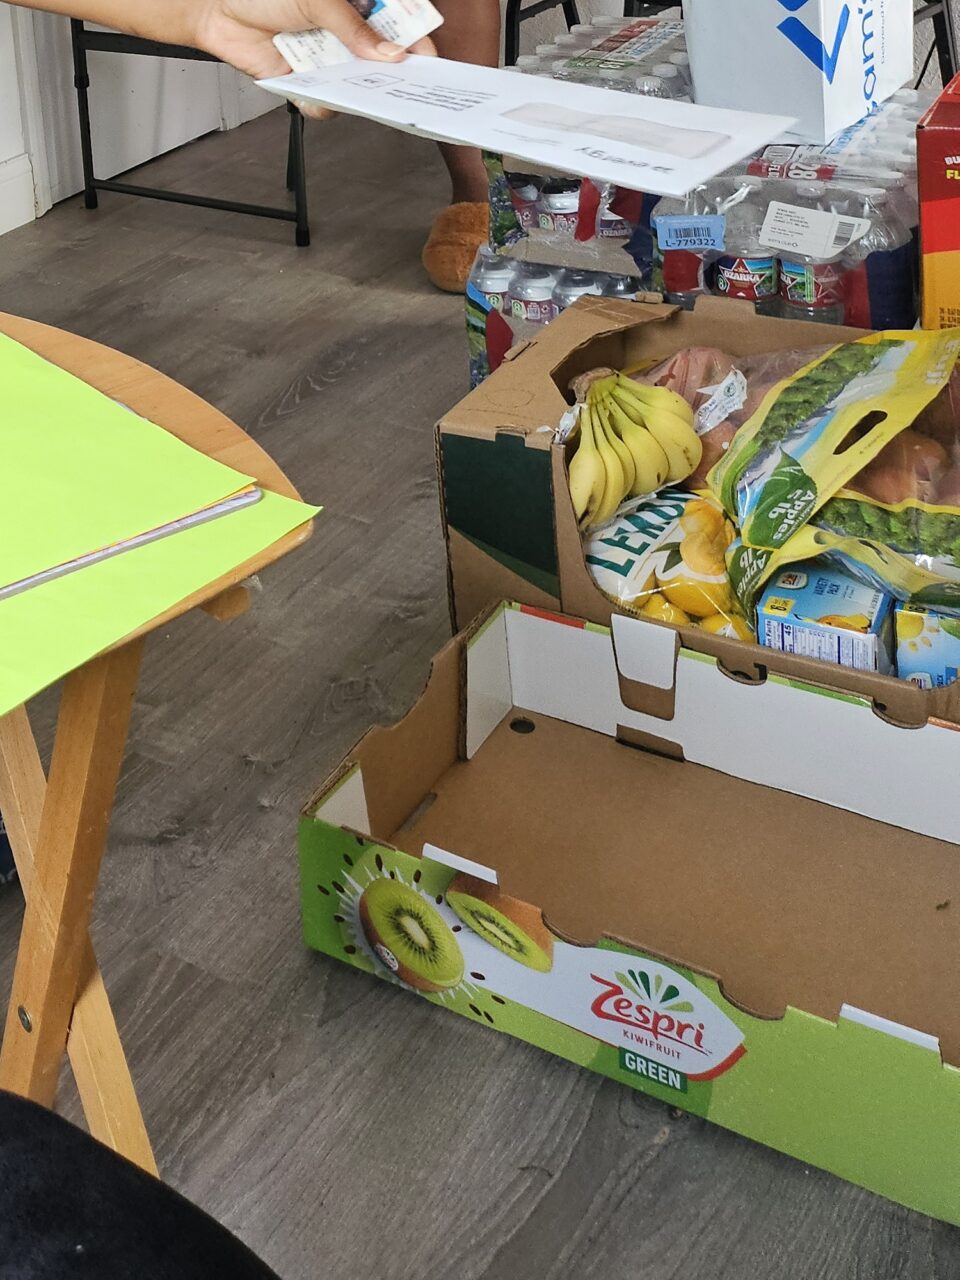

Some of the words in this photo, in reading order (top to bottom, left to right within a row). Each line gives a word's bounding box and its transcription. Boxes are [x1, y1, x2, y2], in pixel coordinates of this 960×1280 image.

[787, 163, 818, 179] 28
[665, 238, 716, 249] L-779322
[723, 269, 761, 284] OZARKA
[767, 501, 787, 519] lb
[770, 490, 815, 541] Apples
[827, 582, 841, 596] PACK
[784, 624, 792, 637] 45
[590, 973, 707, 1052] Zespri
[622, 1028, 682, 1060] KIWIFRUIT
[624, 1052, 682, 1090] GREEN
